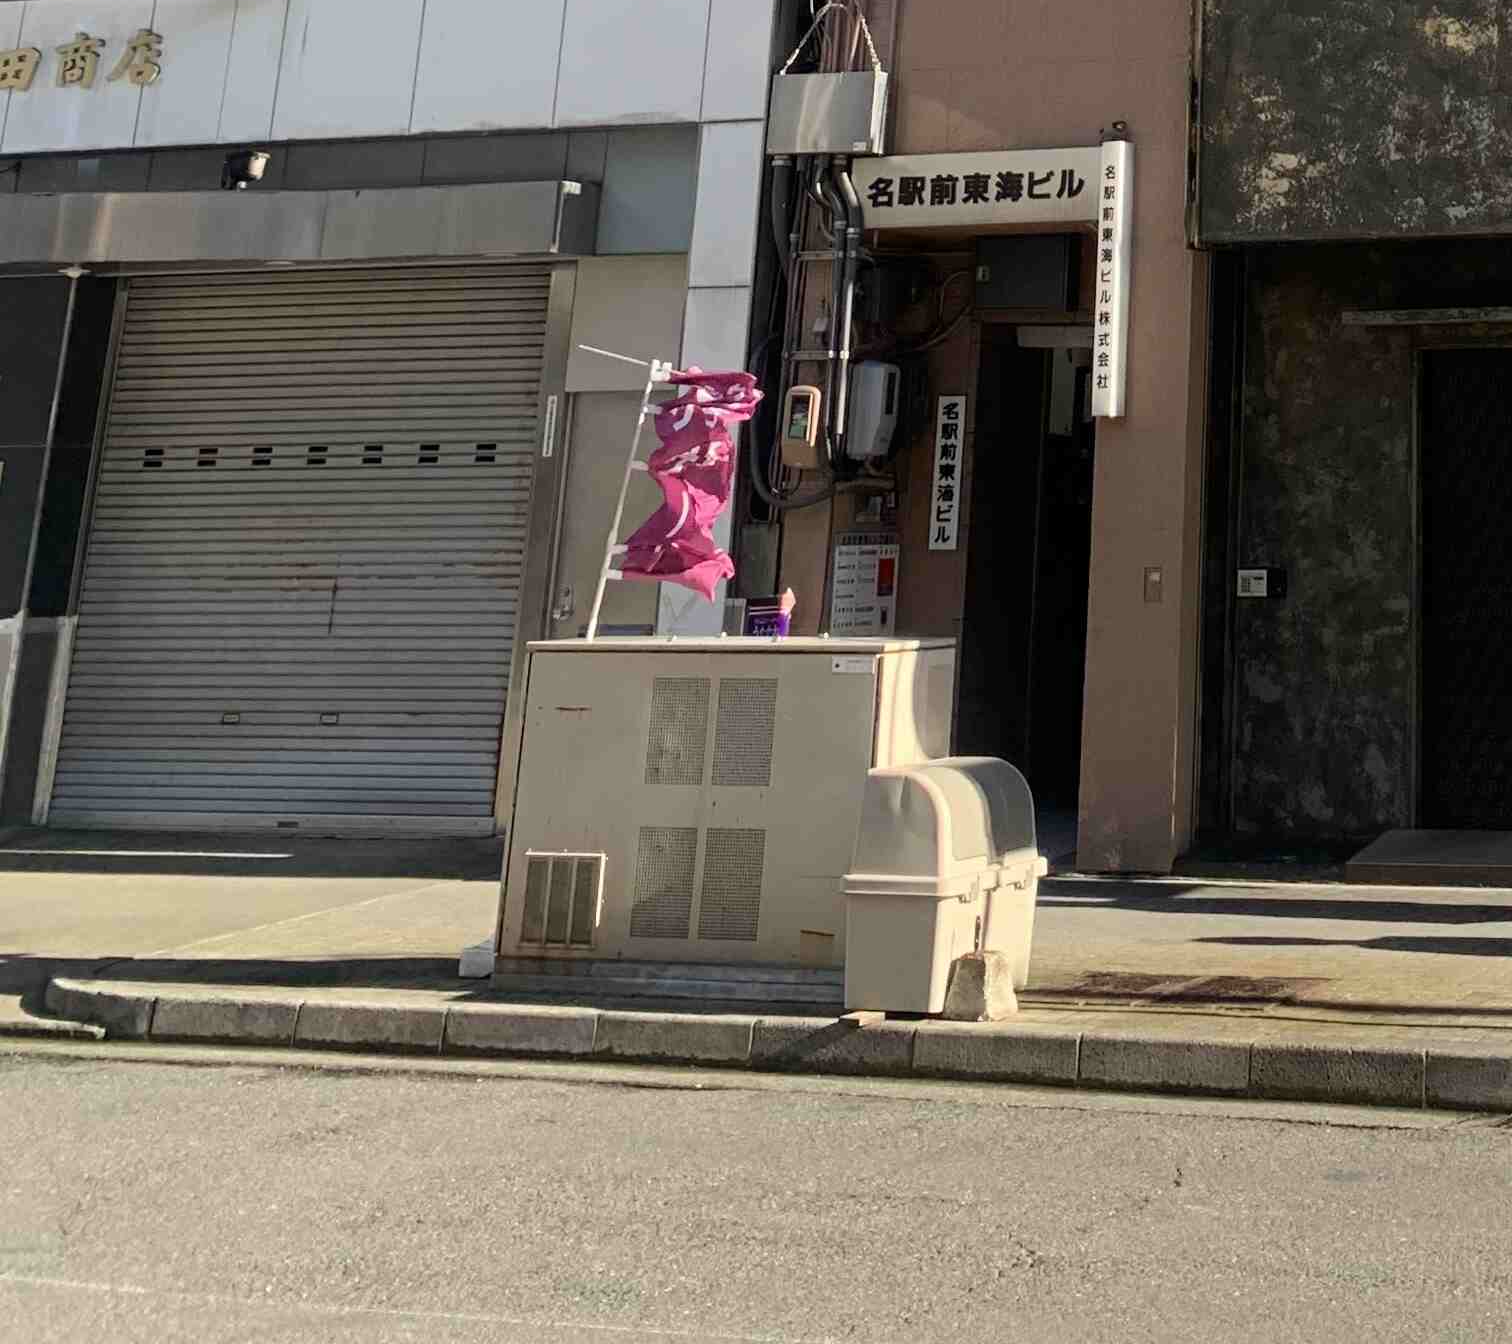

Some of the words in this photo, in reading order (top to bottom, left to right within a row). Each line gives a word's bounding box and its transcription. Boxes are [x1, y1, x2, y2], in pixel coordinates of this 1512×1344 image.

[867, 169, 1085, 208] 名駅前東海ビル
[1096, 165, 1117, 390] 名駅前東海ビル株式会社
[934, 401, 960, 544] 名駅前東海ビル
